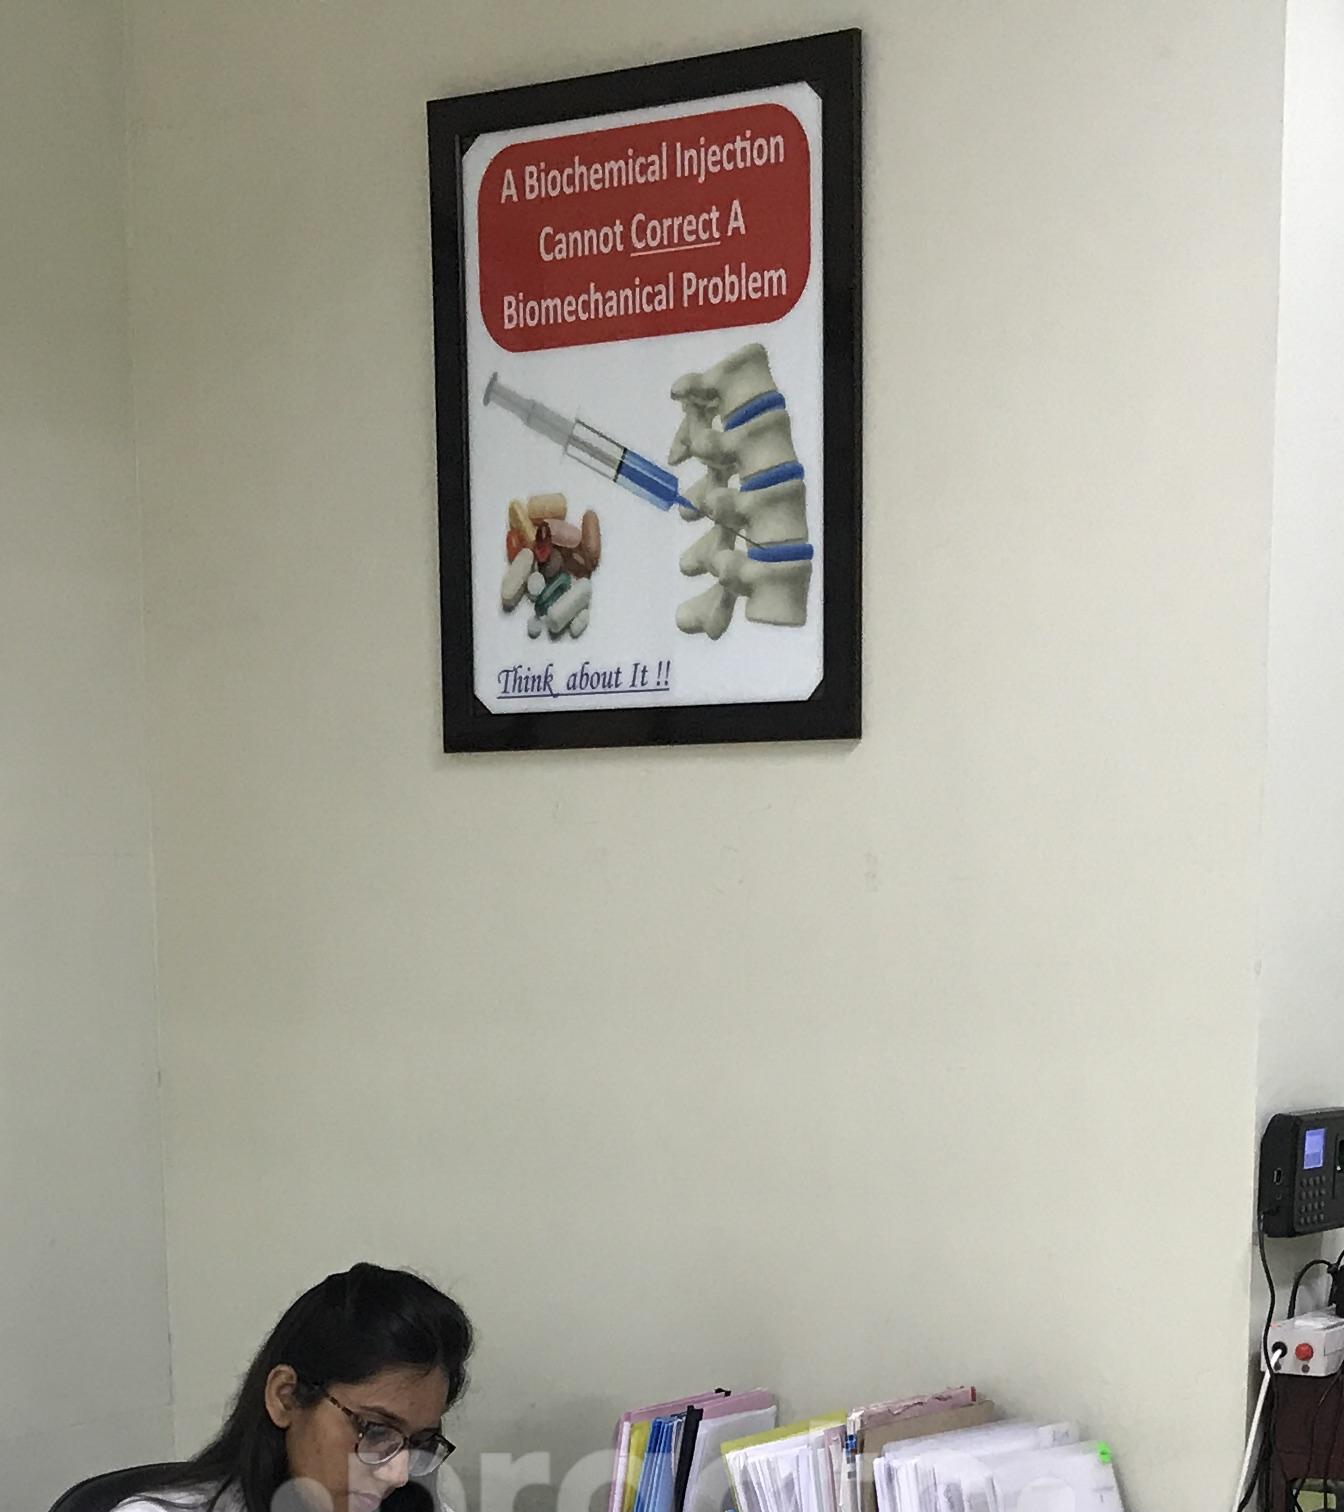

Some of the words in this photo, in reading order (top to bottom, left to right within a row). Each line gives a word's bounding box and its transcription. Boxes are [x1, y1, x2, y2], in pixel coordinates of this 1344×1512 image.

[500, 168, 519, 204] A
[524, 141, 668, 201] Biochemical
[675, 130, 785, 184] Injection
[539, 219, 624, 262] Cannot
[630, 205, 721, 250] Correct
[727, 198, 747, 237] A
[503, 272, 675, 330] Biomechanical
[682, 262, 787, 307] Problem
[497, 663, 555, 695] Think
[565, 660, 623, 691] about
[629, 662, 649, 689] It
[656, 660, 672, 687] !!
